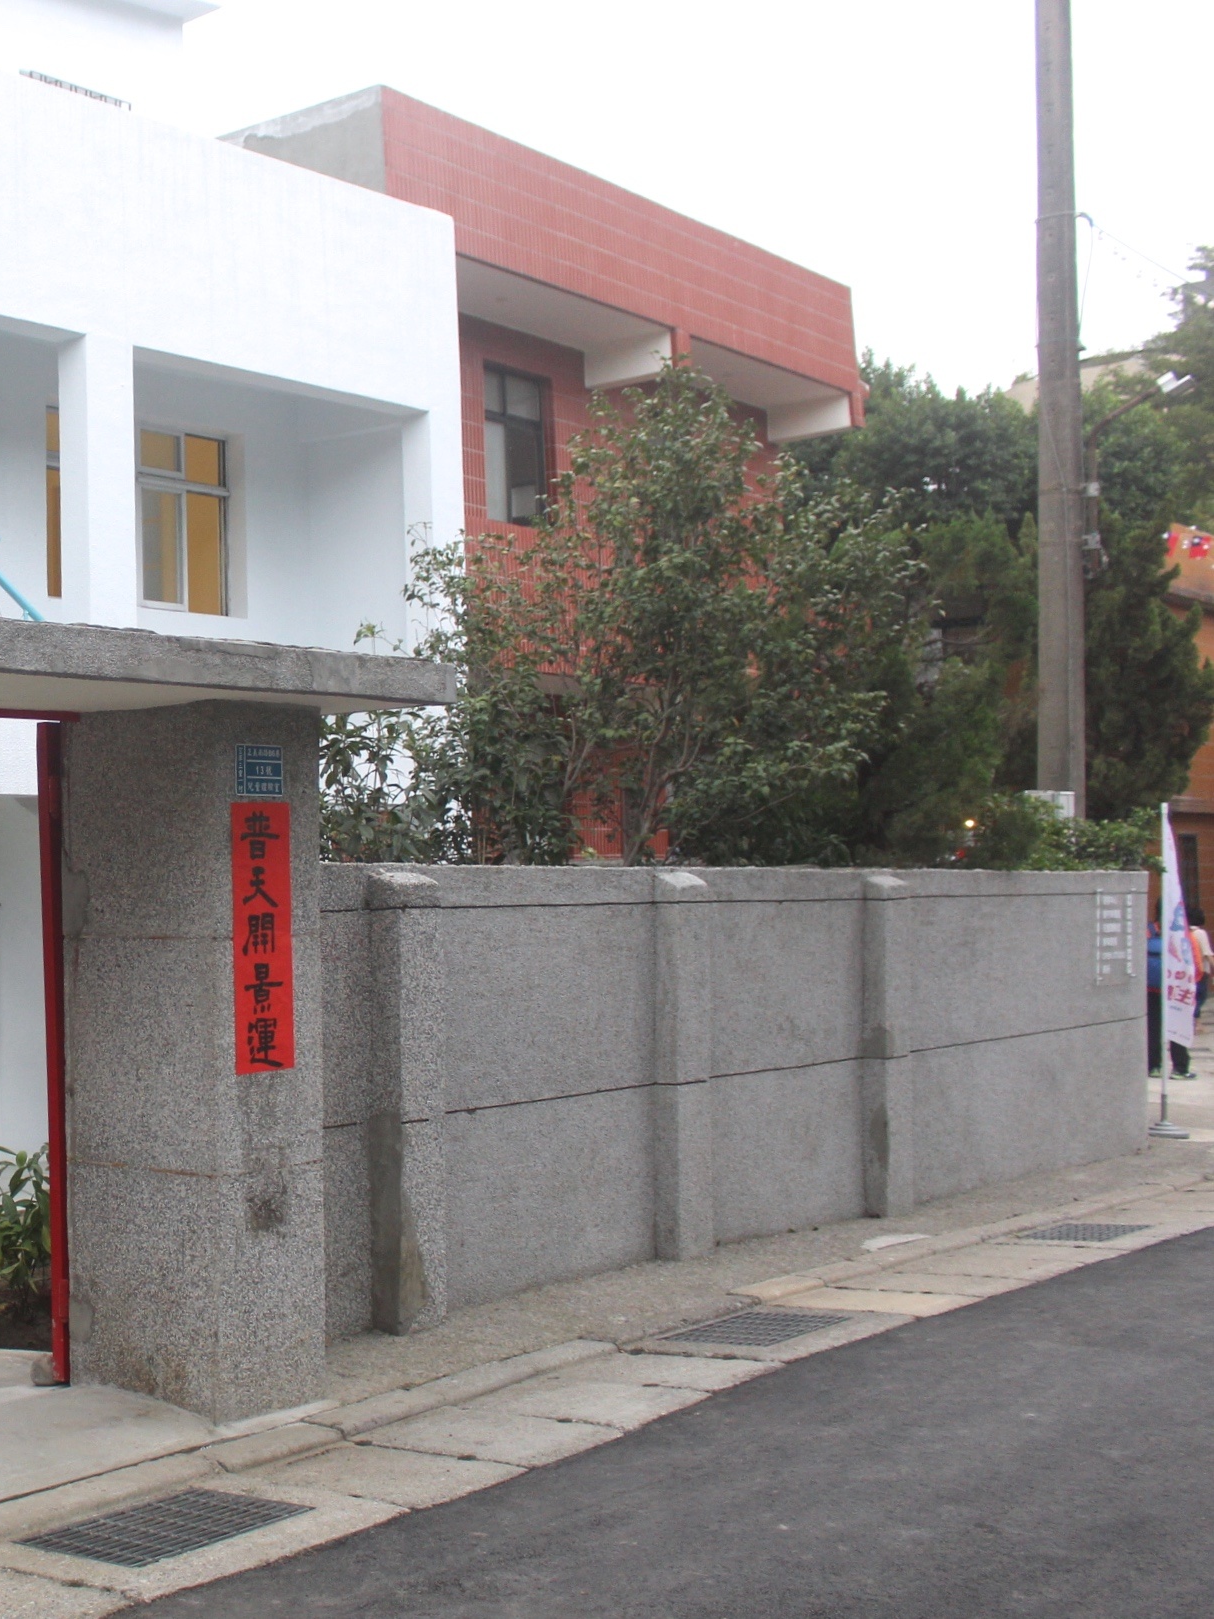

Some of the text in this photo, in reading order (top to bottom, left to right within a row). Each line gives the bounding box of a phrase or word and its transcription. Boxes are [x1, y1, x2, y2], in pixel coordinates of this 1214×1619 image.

[240, 811, 284, 1067] 普天開景運
